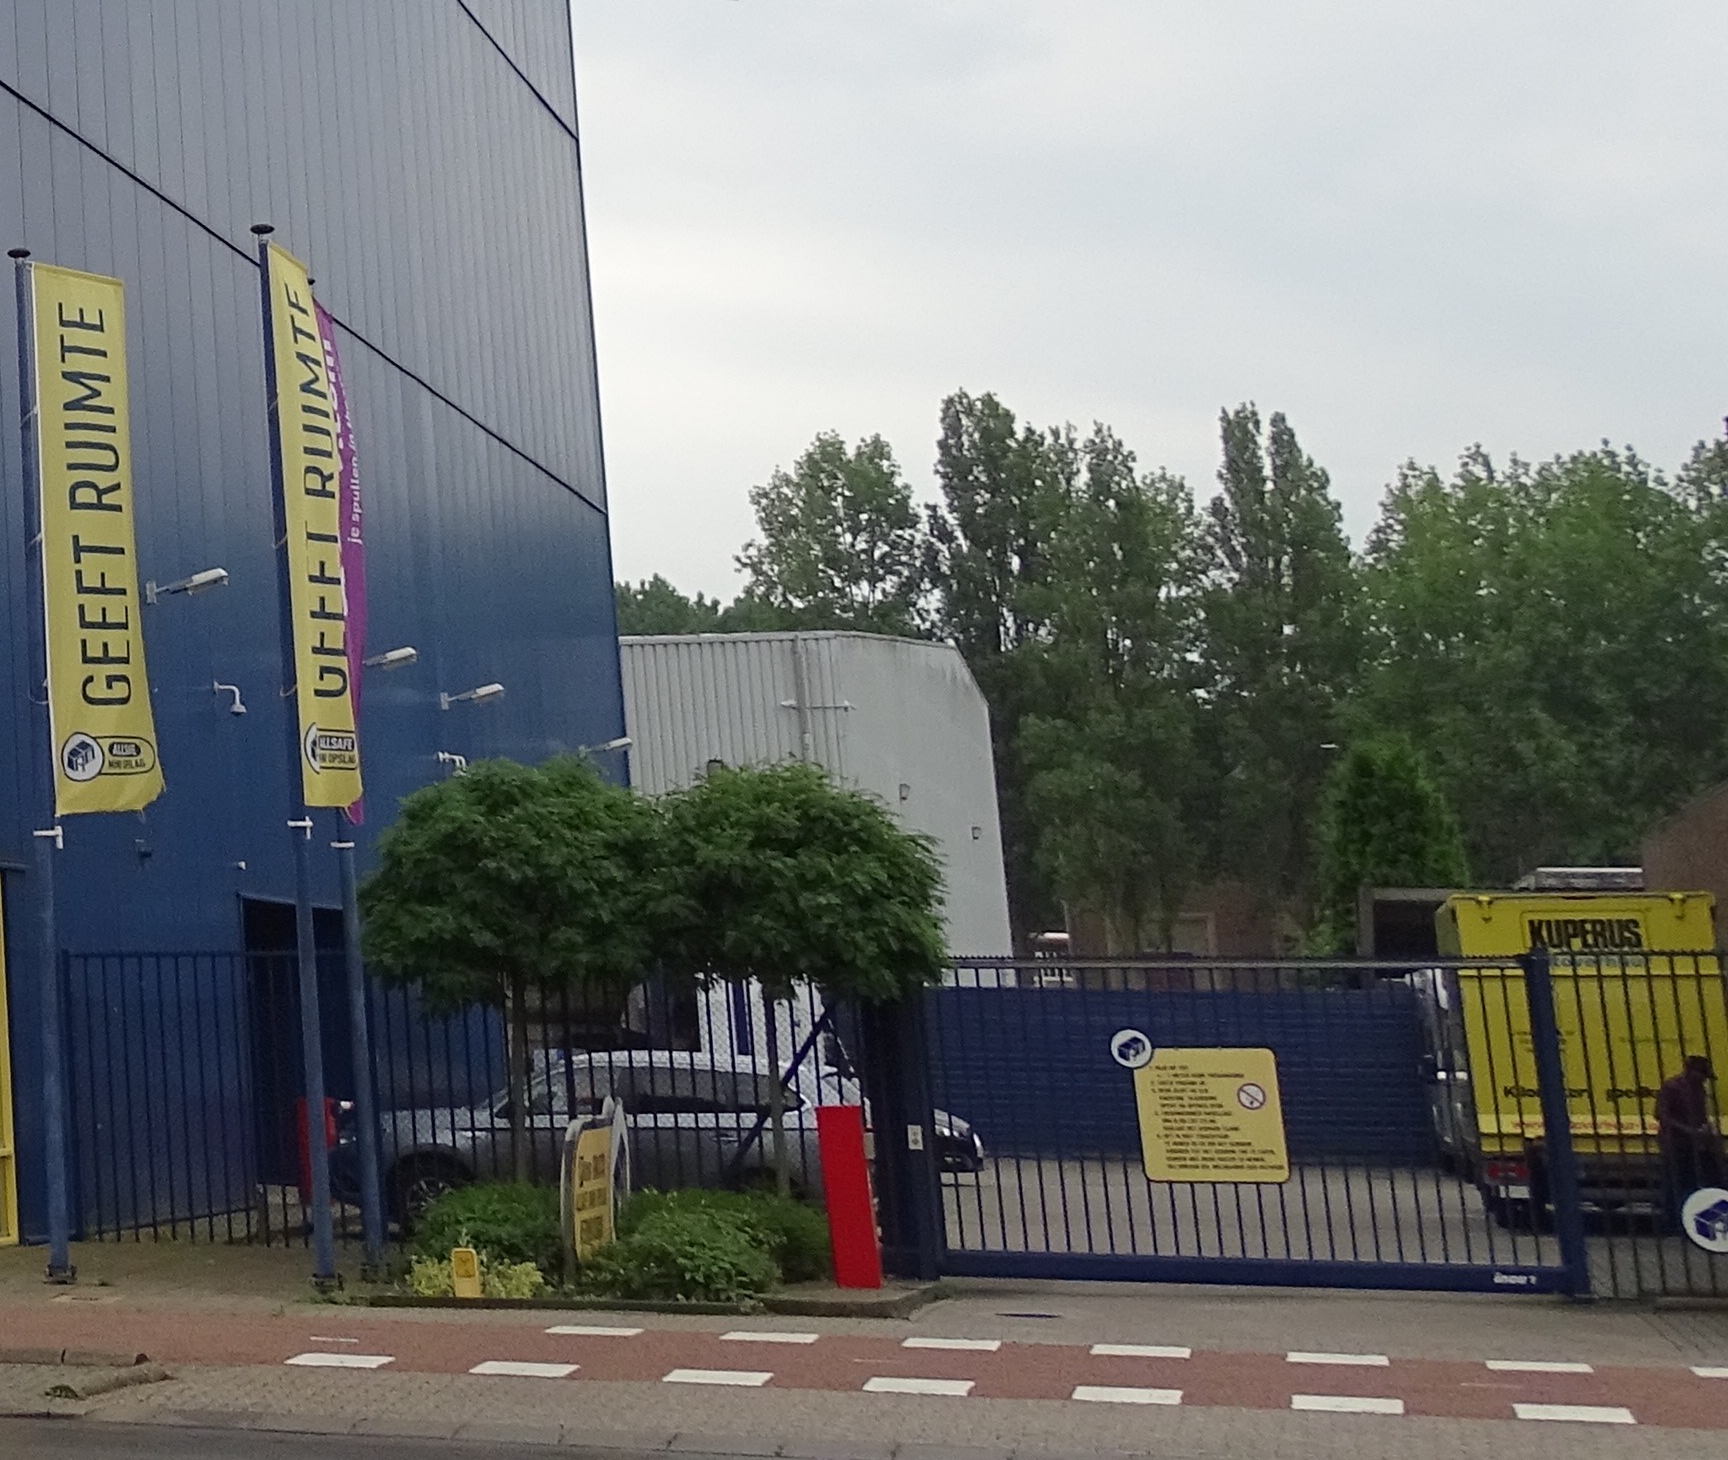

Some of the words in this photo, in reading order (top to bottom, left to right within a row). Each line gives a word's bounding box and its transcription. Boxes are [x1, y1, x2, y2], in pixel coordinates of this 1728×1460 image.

[57, 300, 124, 515] RUIMTE
[71, 534, 132, 708] GEEFT
[1528, 919, 1643, 949] KUPERUS
